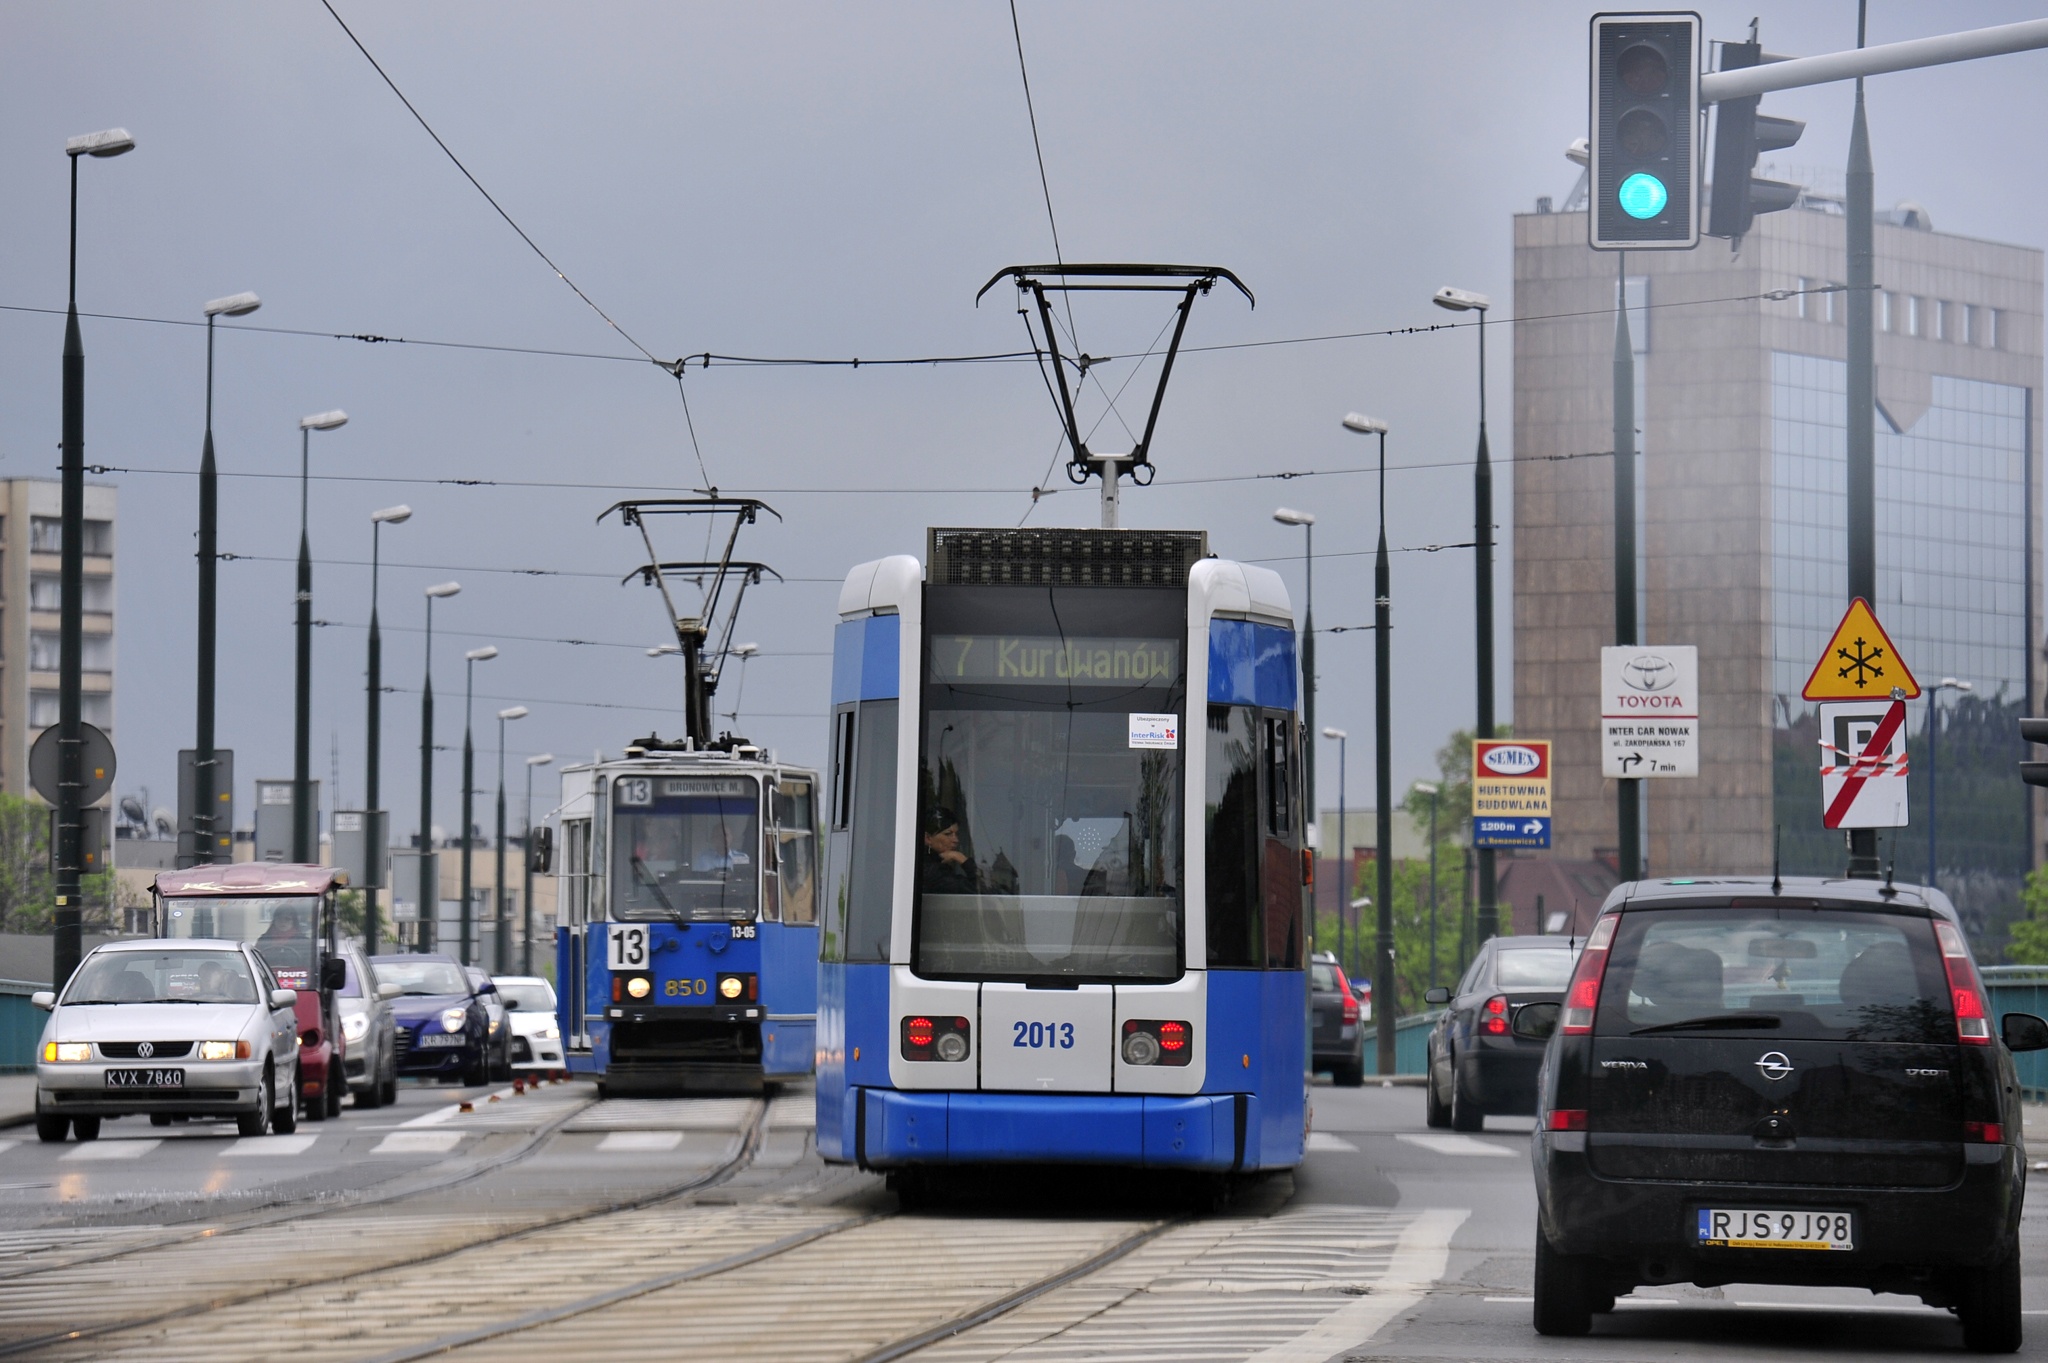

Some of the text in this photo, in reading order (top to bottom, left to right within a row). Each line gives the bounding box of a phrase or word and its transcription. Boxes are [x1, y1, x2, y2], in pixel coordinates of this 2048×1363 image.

[954, 637, 1170, 680] 7 Kurdwanów
[1617, 695, 1683, 708] TOYOTA
[1131, 731, 1165, 739] InterRisk
[1609, 727, 1690, 736] INTER CAR NOWAK
[1613, 739, 1622, 747] ul.
[1624, 738, 1671, 747] ZAKOPIAŃSKA
[1488, 750, 1535, 766] SEMEX
[1650, 759, 1676, 772] 7 min
[625, 780, 649, 802] 13
[669, 781, 740, 793] BRONOWICE M.
[1478, 785, 1547, 796] HURTOWNIA
[1477, 800, 1548, 810] BUDOWLANA
[730, 926, 756, 939] 13-05
[611, 929, 644, 965] 13
[277, 970, 308, 978] tours
[664, 978, 707, 997] 850
[1013, 1020, 1075, 1049] 2013
[107, 1069, 182, 1085] KVX 7860
[1700, 1211, 1848, 1241] PL RJS 9J98
